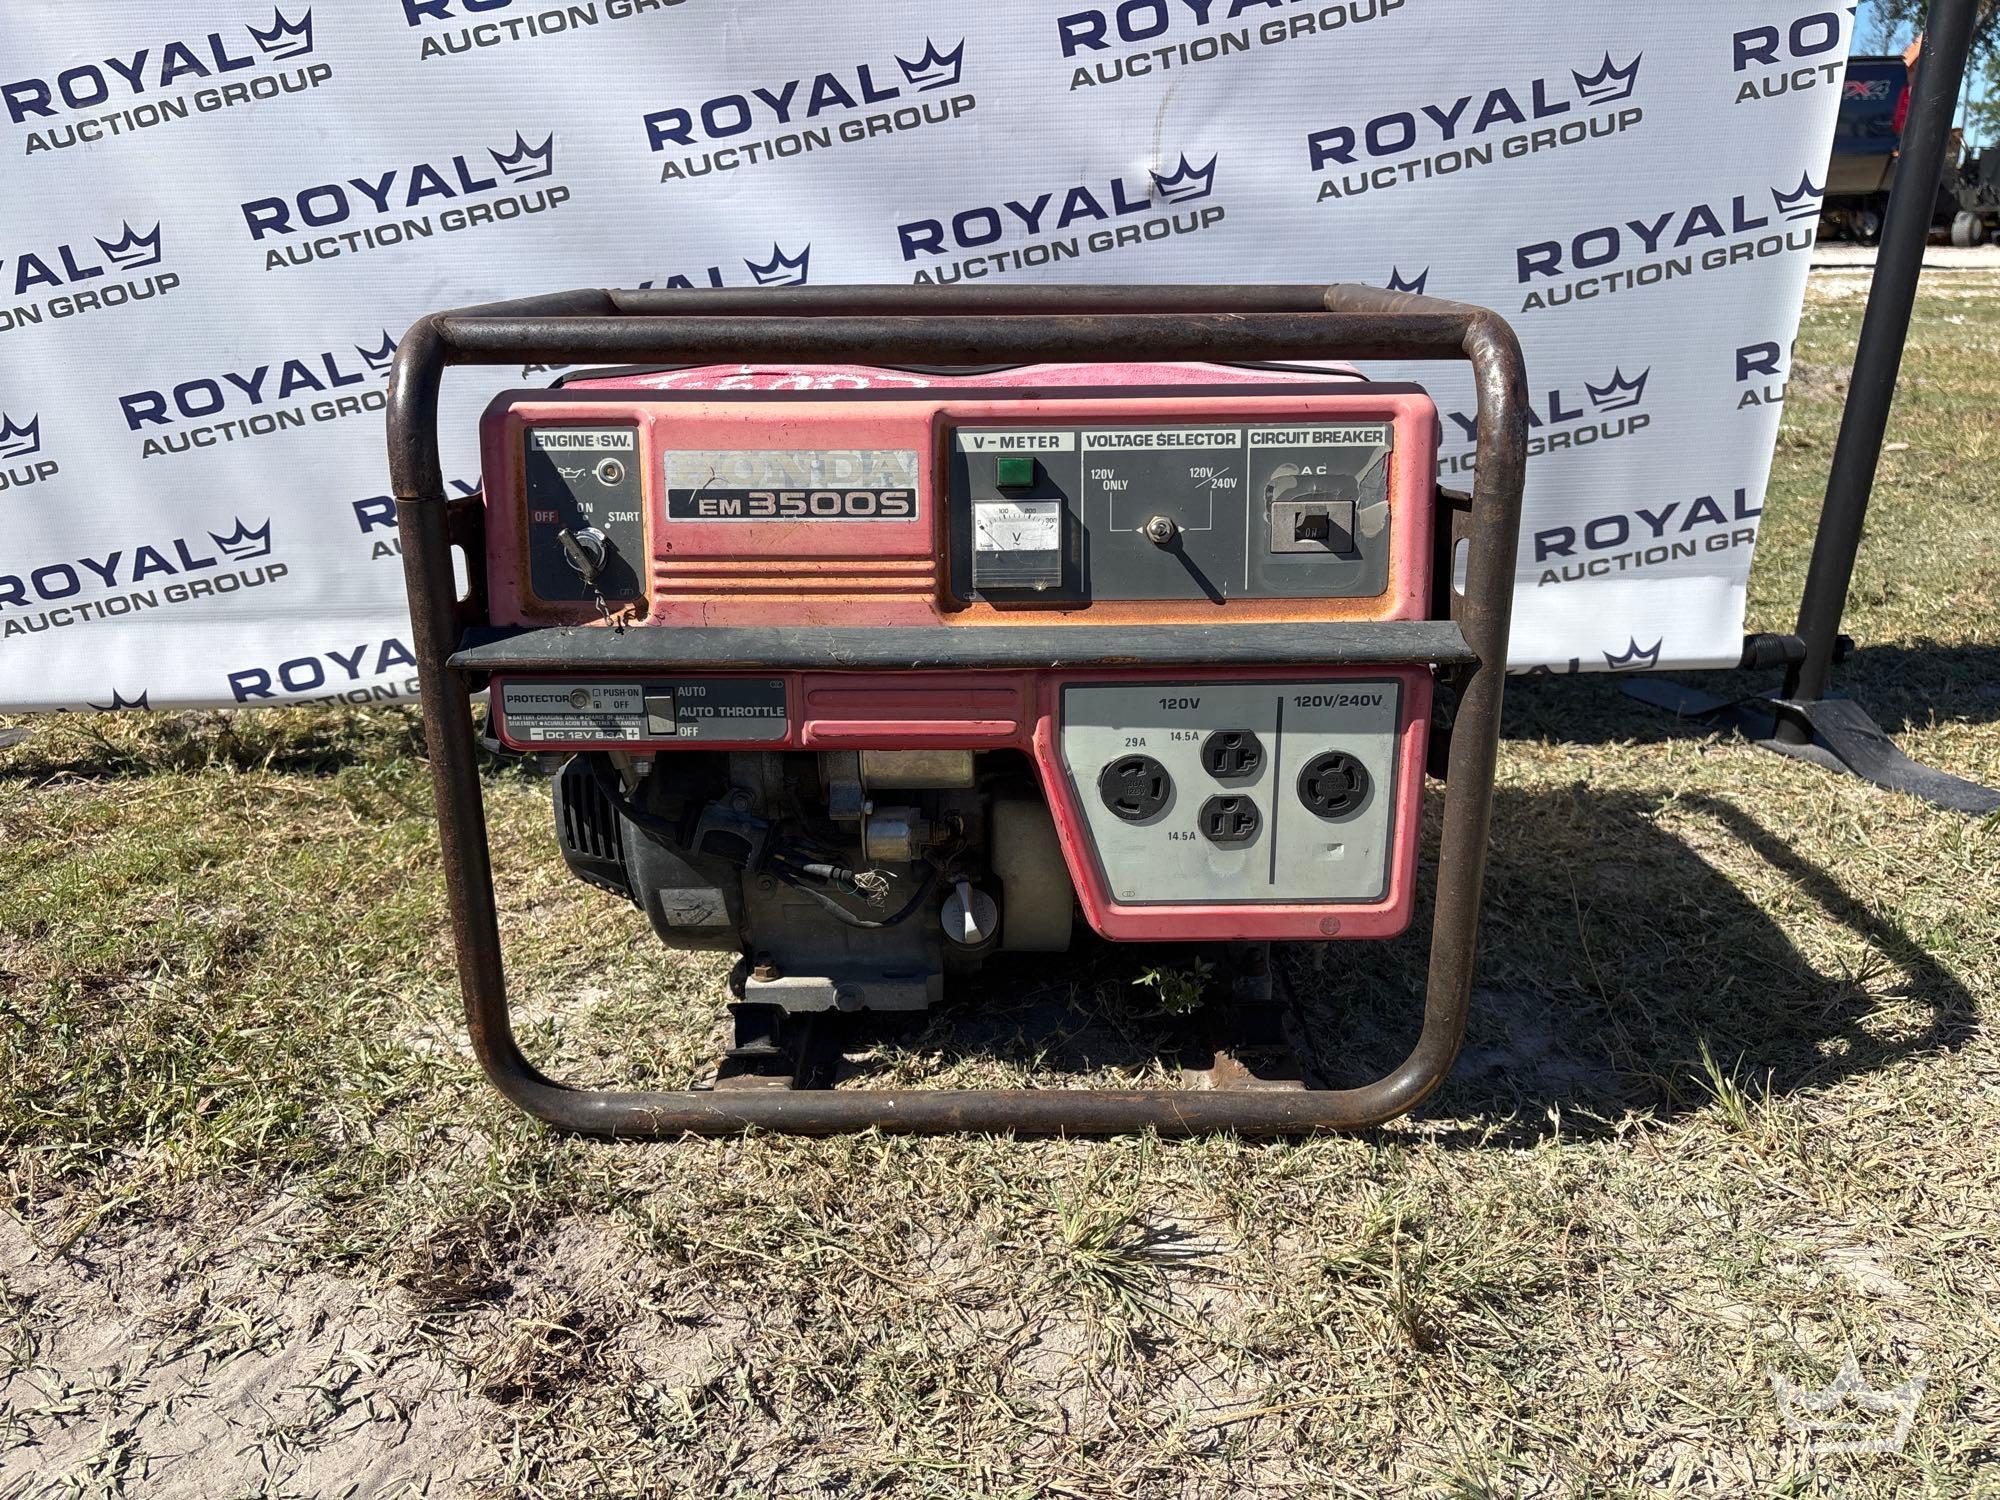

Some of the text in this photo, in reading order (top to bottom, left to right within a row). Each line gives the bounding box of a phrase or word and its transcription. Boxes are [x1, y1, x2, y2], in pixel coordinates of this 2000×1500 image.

[420, 2, 598, 60] AUCTION
[1057, 0, 1302, 58] ROY
[1070, 0, 1404, 91] AUCTION GROUP
[1, 33, 255, 124] ROYAL
[1735, 61, 1844, 104] AUCT
[25, 63, 333, 155] AUCTION GROUP
[643, 63, 901, 152] ROYAL
[1307, 79, 1571, 171] ROYAL
[660, 94, 976, 184] AUCTION GROUP
[1316, 108, 1643, 203] AUCTION GROUP
[241, 156, 497, 240] ROYAL
[266, 185, 571, 271] AUCTION GROUP
[897, 178, 1152, 262] ROYAL
[1516, 196, 1769, 283] ROYAL
[913, 206, 1225, 285] AUCTION GROUP
[1520, 228, 1812, 313] AUCTION GROU
[48, 272, 180, 318] GROUP
[118, 352, 365, 431] ROYAL
[142, 390, 388, 459] AUCTION GRO
[536, 435, 631, 447] ENGINE SW.
[973, 436, 1060, 448] V-METER
[1086, 432, 1236, 447] VOLTAGE SELECTOR
[1251, 431, 1383, 445] CIRCUIT BREAKER
[1526, 413, 1650, 457] GROUP
[679, 453, 915, 488] ONDA
[1091, 469, 1115, 480] 120V
[1103, 480, 1128, 491] ONLY
[1211, 478, 1238, 489] 240V
[534, 511, 555, 522] OFF
[576, 503, 594, 513] ON
[608, 511, 640, 522] START
[699, 491, 909, 515] EM 3500S
[1012, 532, 1021, 542] V
[1305, 527, 1318, 538] ON
[1534, 488, 1762, 562] ROYAL
[0, 538, 217, 610] ROYAL
[1538, 540, 1697, 588] AUCTION
[3, 563, 289, 638] AUCTION GROUP
[228, 638, 418, 703] ROYA
[506, 695, 570, 703] PROTECTOR
[613, 701, 630, 709] OFF
[678, 686, 706, 697] AUTO
[1159, 698, 1201, 710] 120V
[1293, 694, 1383, 708] 120V/240V
[679, 706, 785, 717] AUTO THROTTLE
[546, 731, 565, 739] DC
[568, 731, 593, 739] 12V
[679, 726, 699, 737] OFF
[1125, 737, 1147, 747] 29A
[1170, 731, 1200, 742] 14.5A
[1168, 831, 1197, 841] 14.5A
